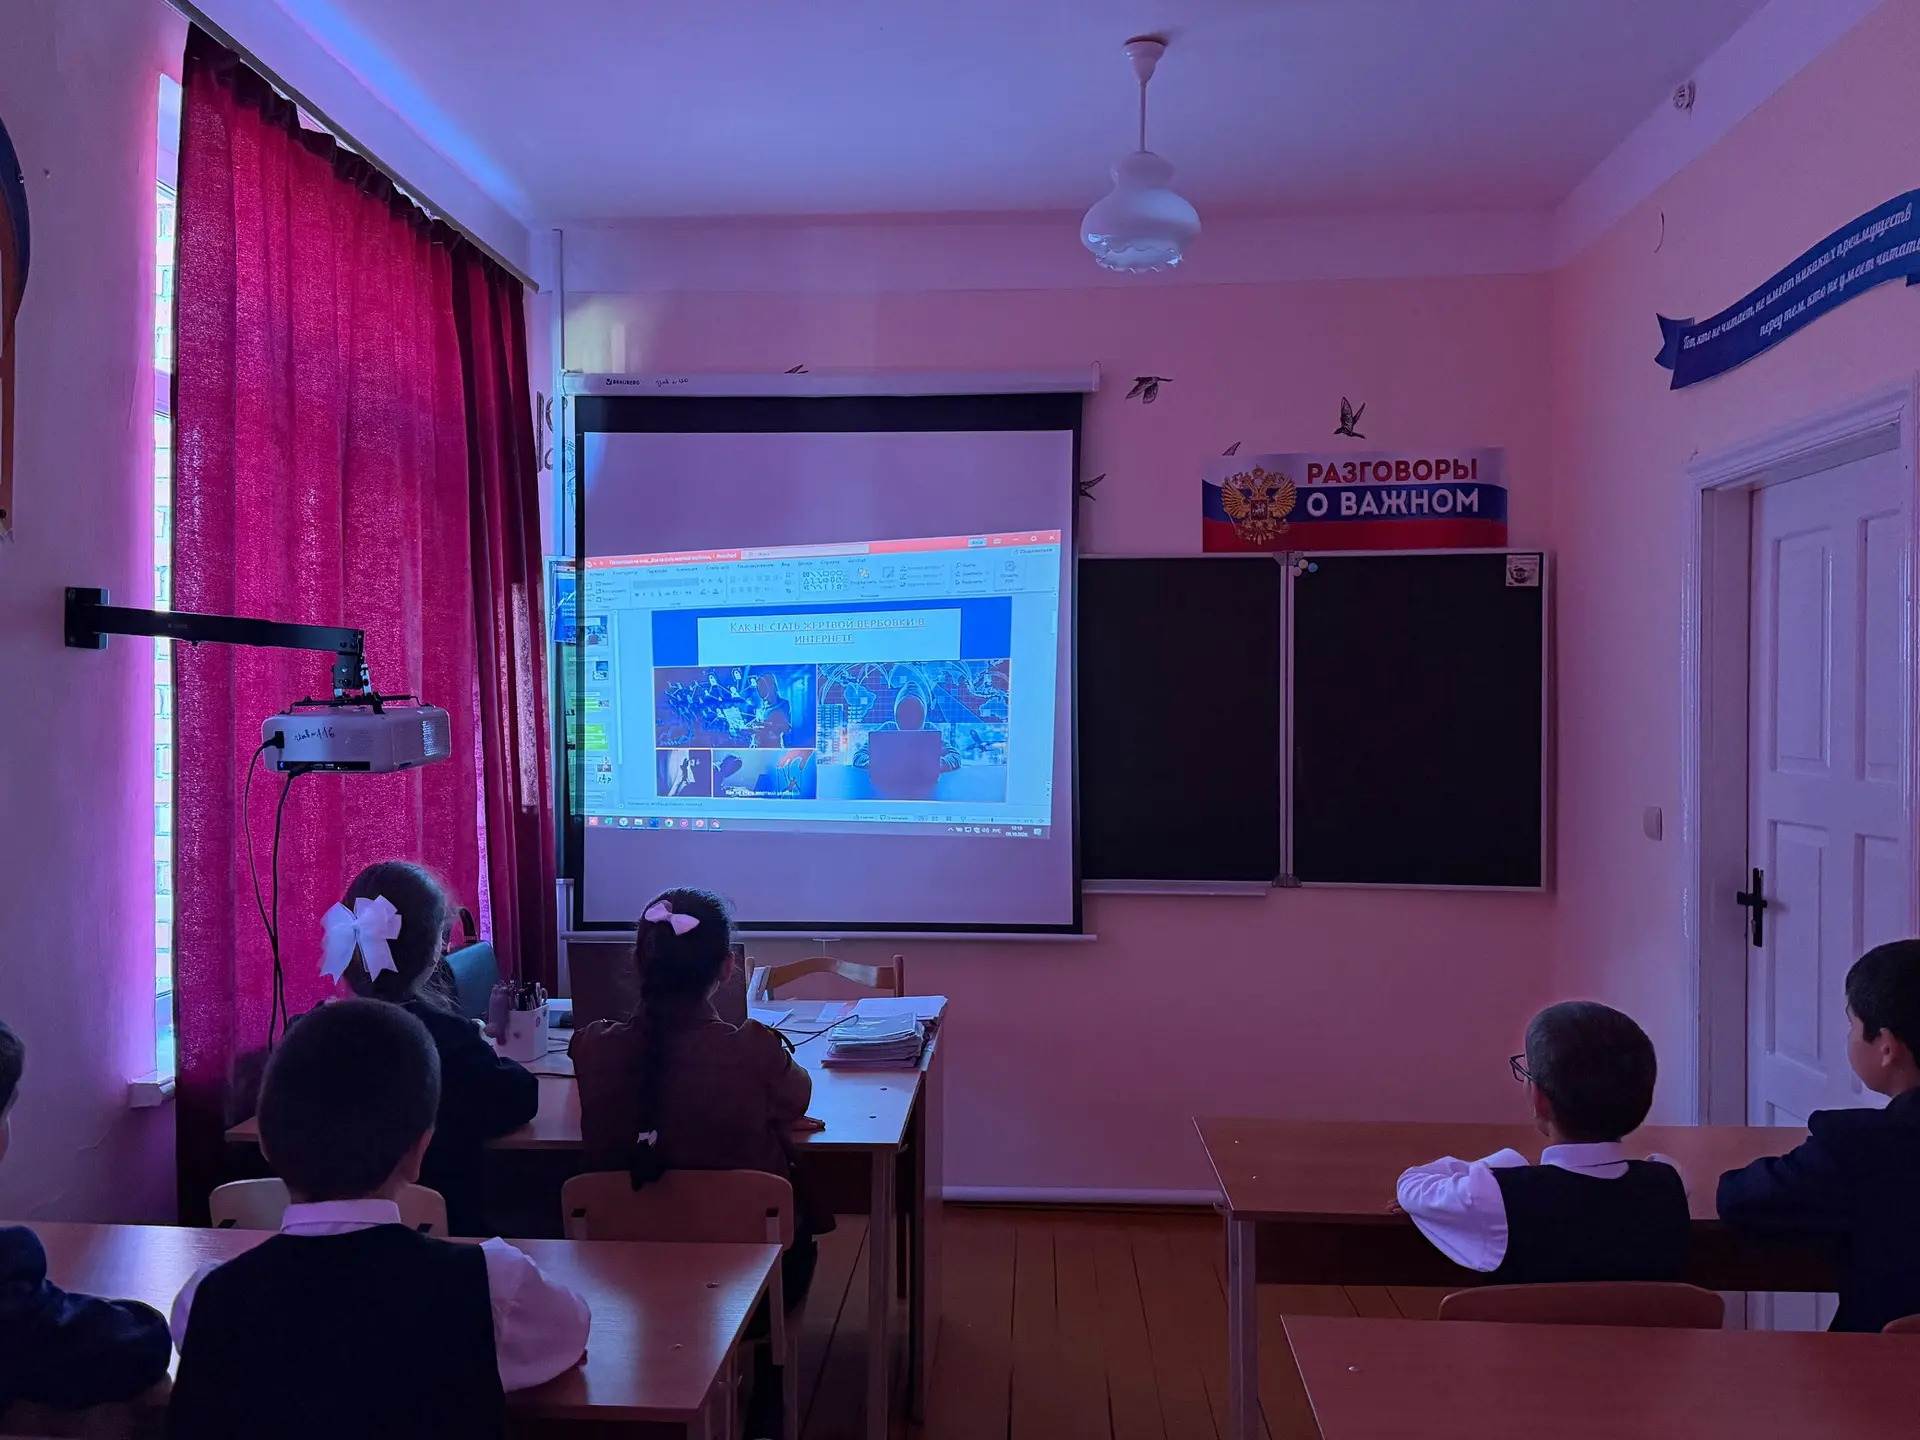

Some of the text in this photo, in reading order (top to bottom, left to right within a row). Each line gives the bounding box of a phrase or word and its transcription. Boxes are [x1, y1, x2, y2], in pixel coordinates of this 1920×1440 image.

[1697, 330, 1712, 345] кто
[1712, 325, 1721, 339] не
[1755, 298, 1766, 313] не
[1766, 277, 1795, 306] имеет
[1795, 246, 1836, 286] никаких
[1836, 202, 1913, 258] преимуществ
[1759, 313, 1784, 337] перед
[1806, 285, 1827, 307] кто
[1827, 277, 1840, 295] не
[1839, 257, 1875, 292] умеет
[1307, 458, 1478, 484] РАЗГОВОРЫ
[1307, 488, 1479, 517] О ВАЖНОМ
